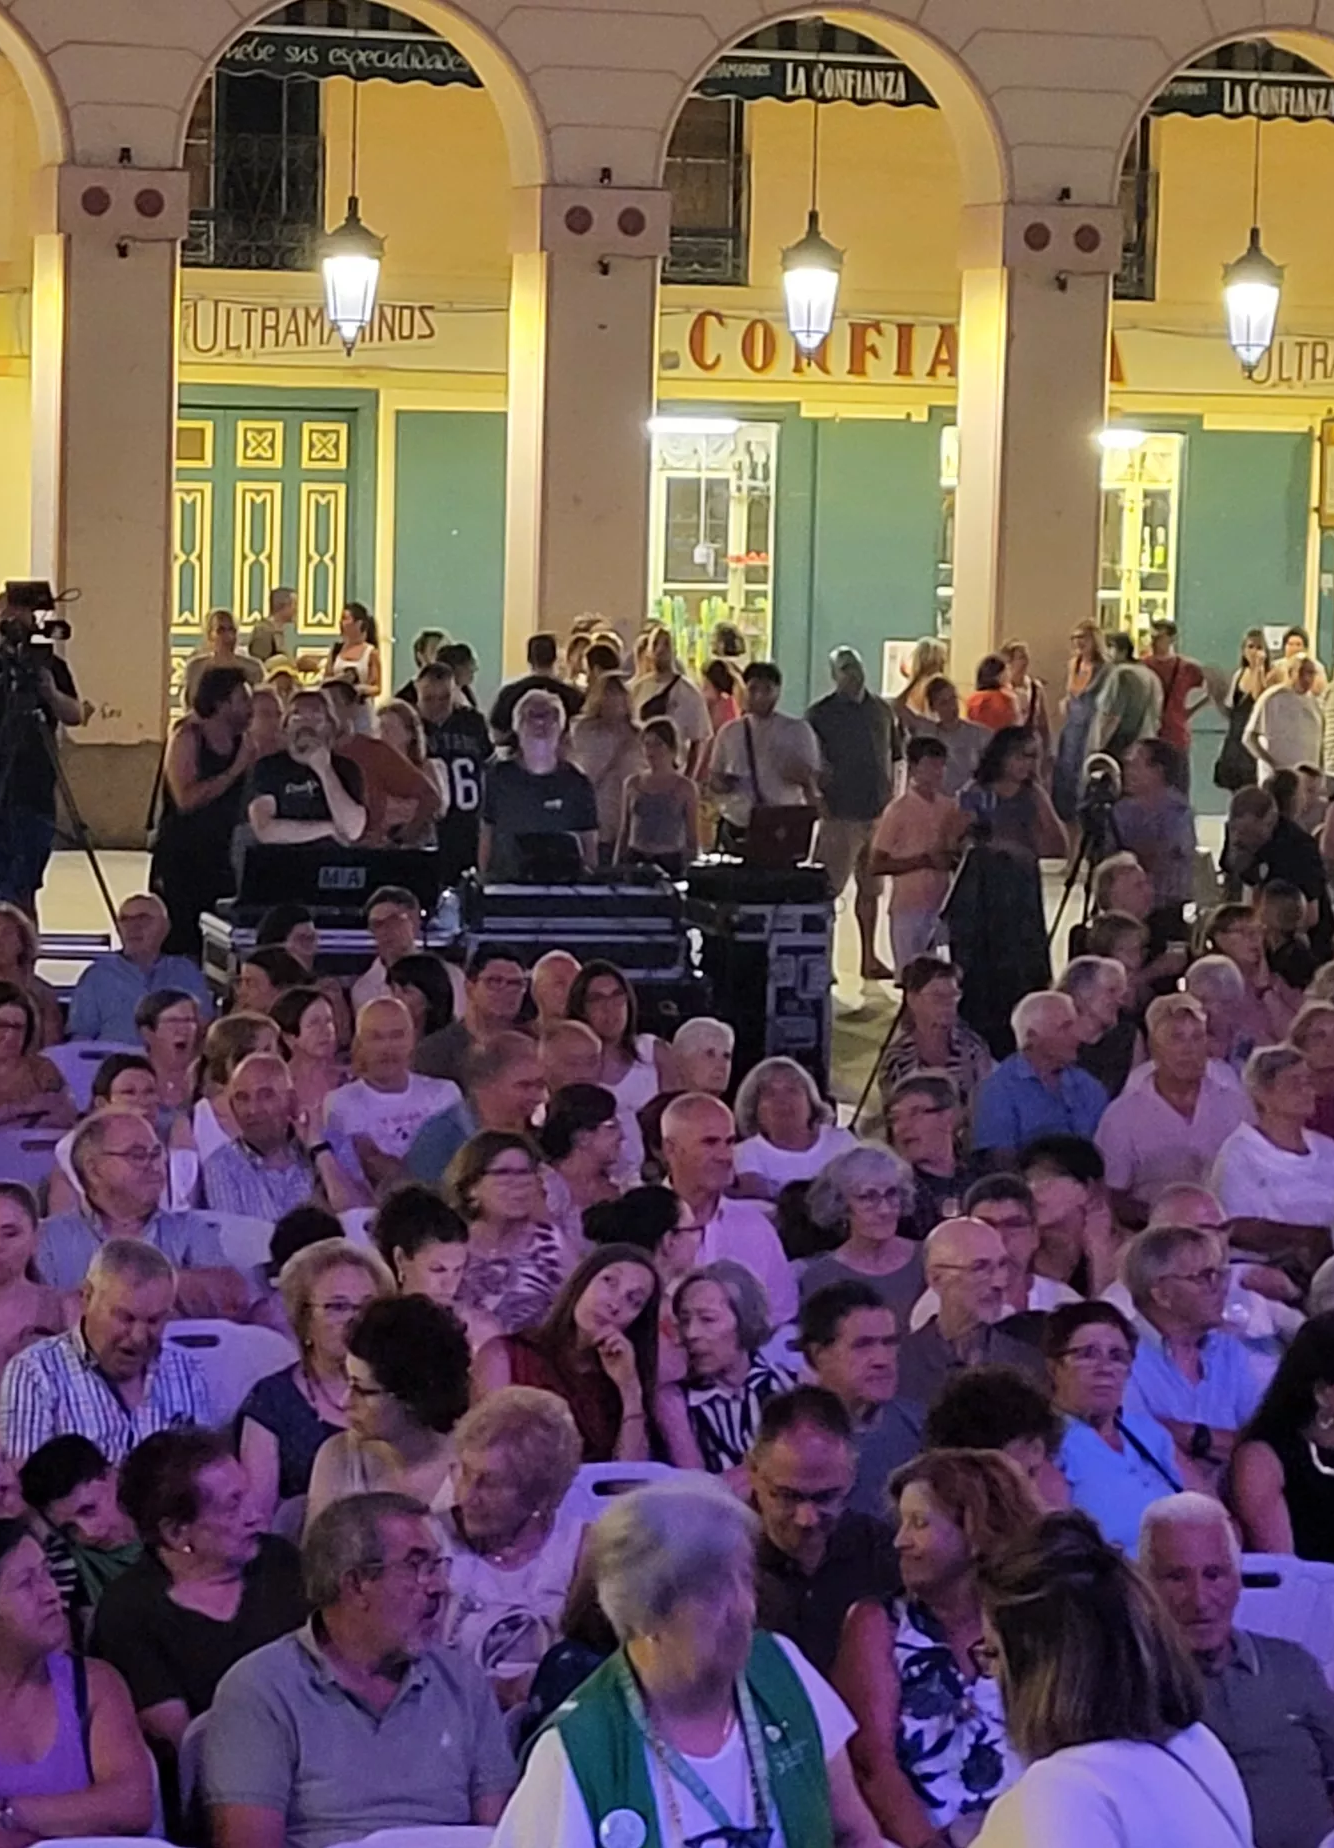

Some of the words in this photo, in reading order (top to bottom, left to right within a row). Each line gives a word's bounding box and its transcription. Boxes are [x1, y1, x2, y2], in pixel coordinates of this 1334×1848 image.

[284, 44, 319, 64] sus
[785, 62, 806, 96] LA
[812, 63, 907, 100] CONFIANZA
[1223, 80, 1243, 113] LA
[193, 299, 435, 353] ULTRAMINOS
